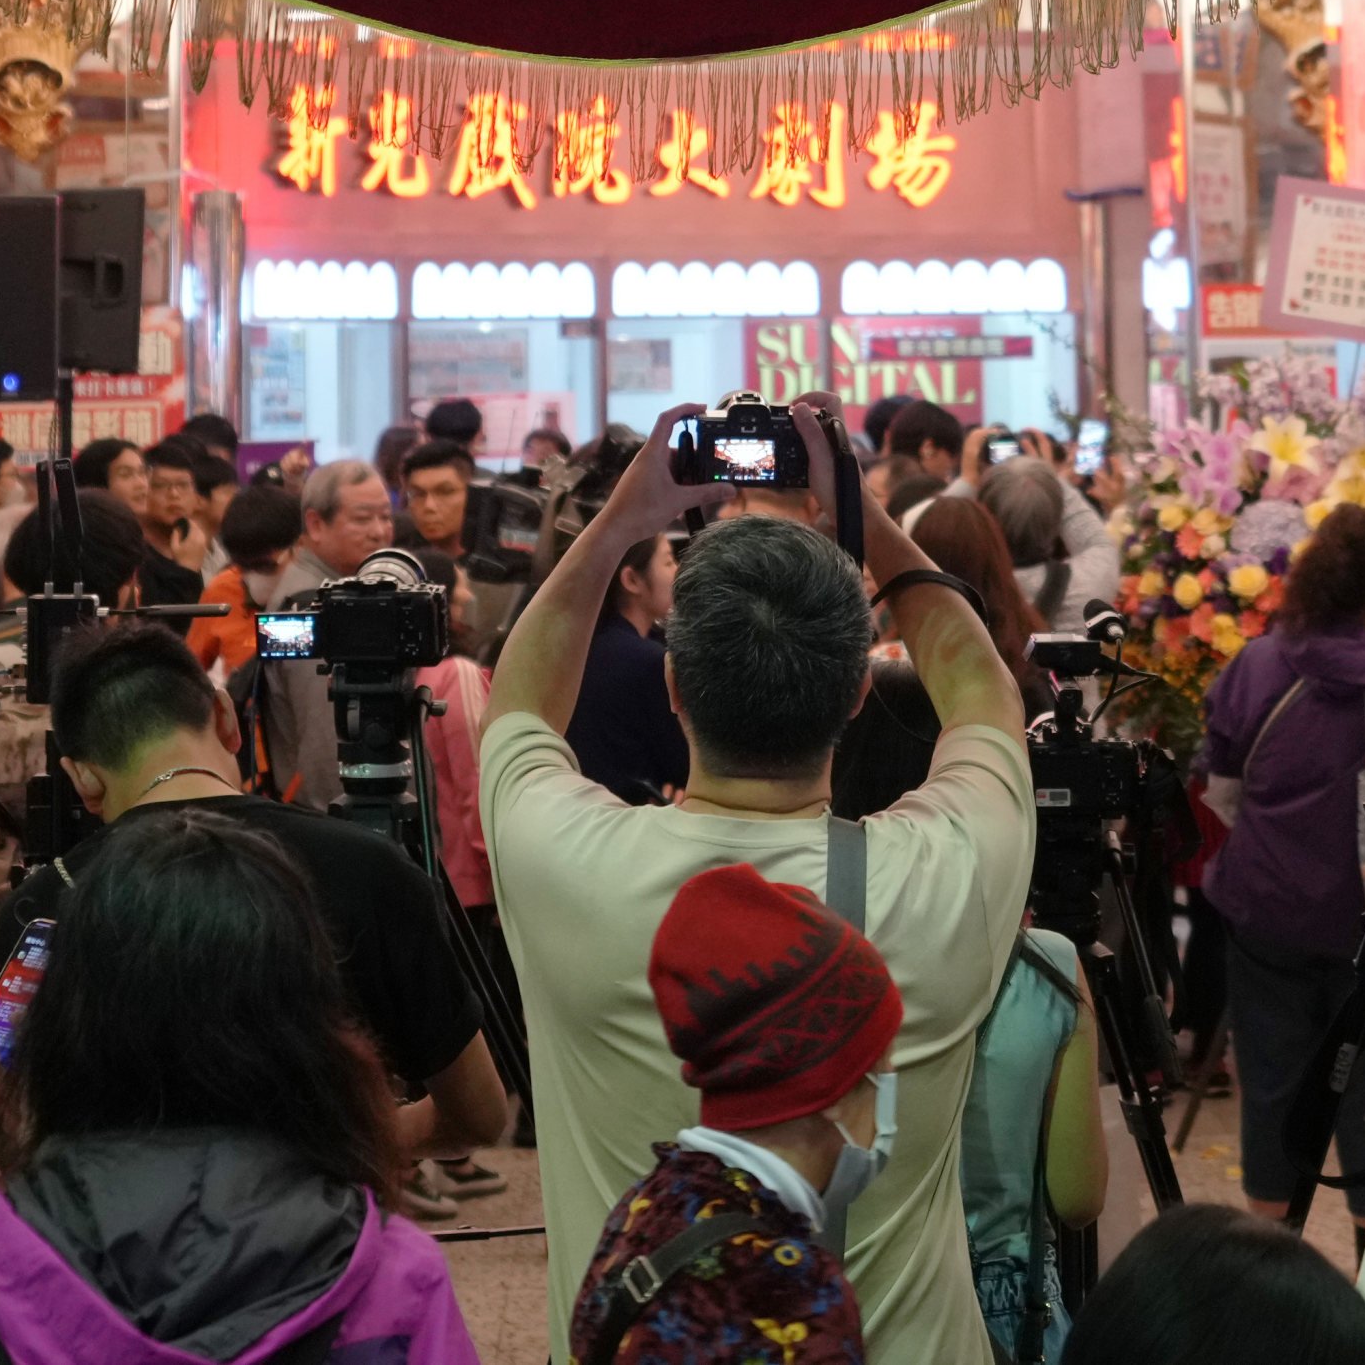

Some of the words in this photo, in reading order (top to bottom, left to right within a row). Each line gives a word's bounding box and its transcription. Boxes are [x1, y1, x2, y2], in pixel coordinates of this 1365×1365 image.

[275, 87, 958, 211] 新光戲院大劇場
[758, 360, 977, 405] DIGITAL
